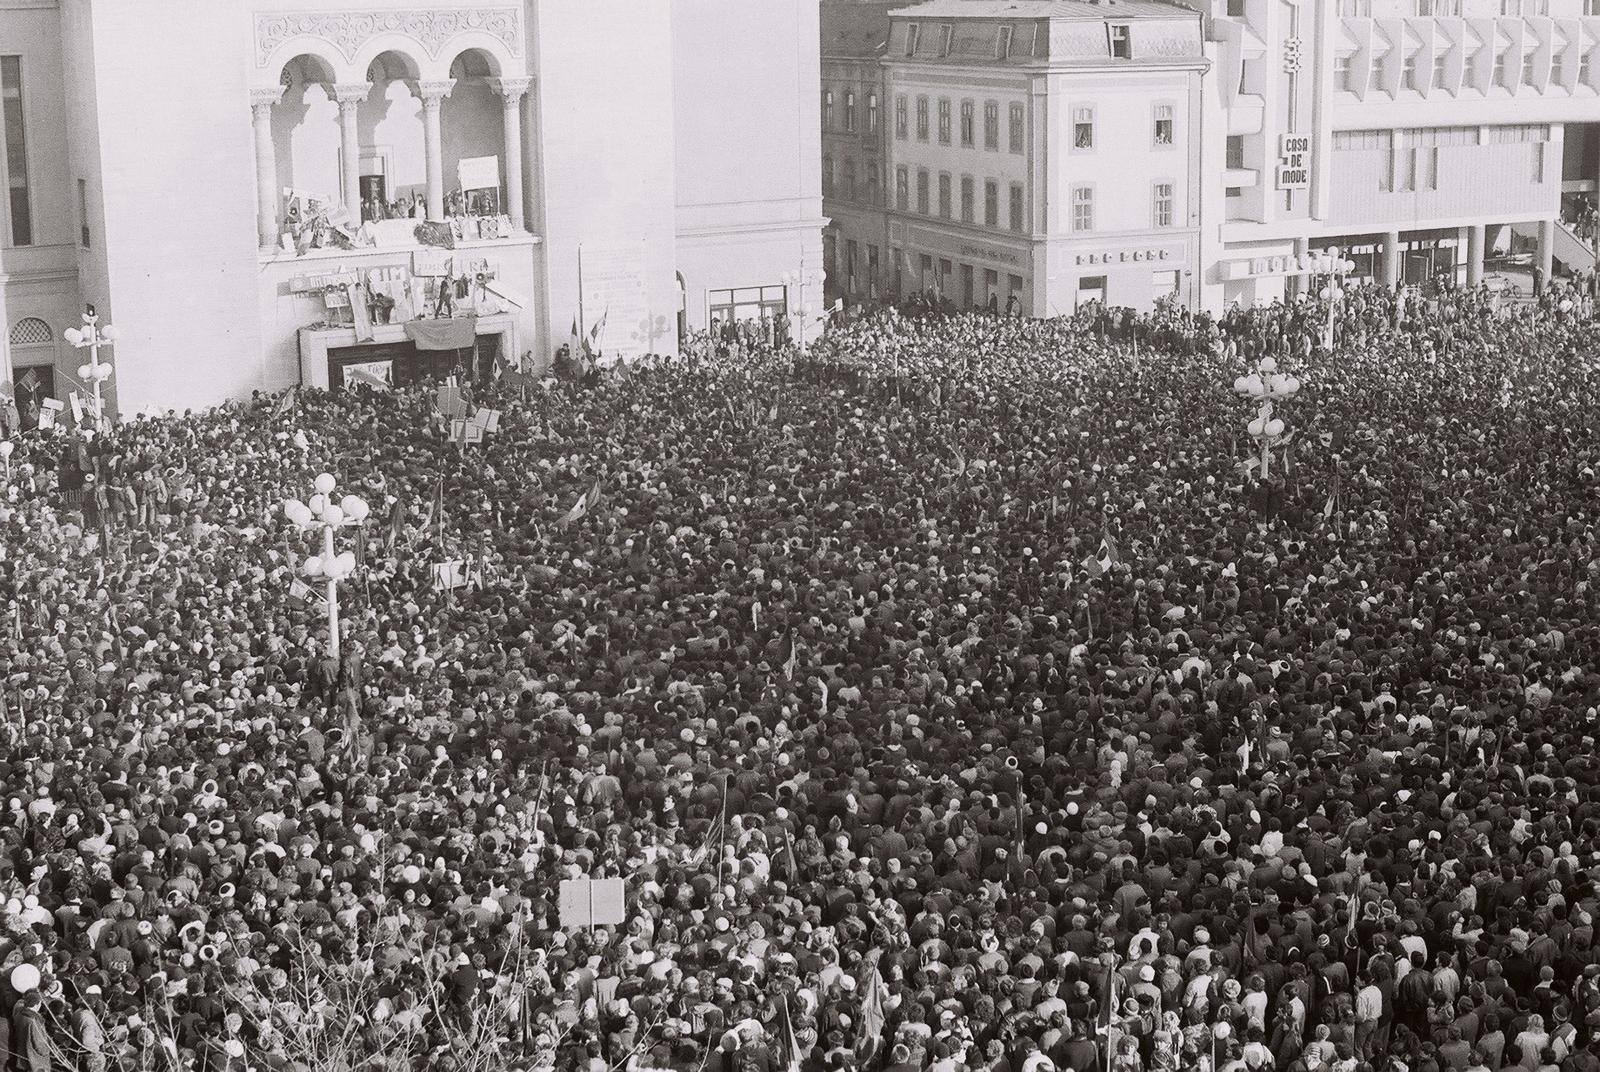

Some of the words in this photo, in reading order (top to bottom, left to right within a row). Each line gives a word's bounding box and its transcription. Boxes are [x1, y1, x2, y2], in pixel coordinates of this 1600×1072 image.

[1286, 138, 1308, 152] CASA
[1291, 154, 1302, 168] DE
[1282, 169, 1307, 183] MODE
